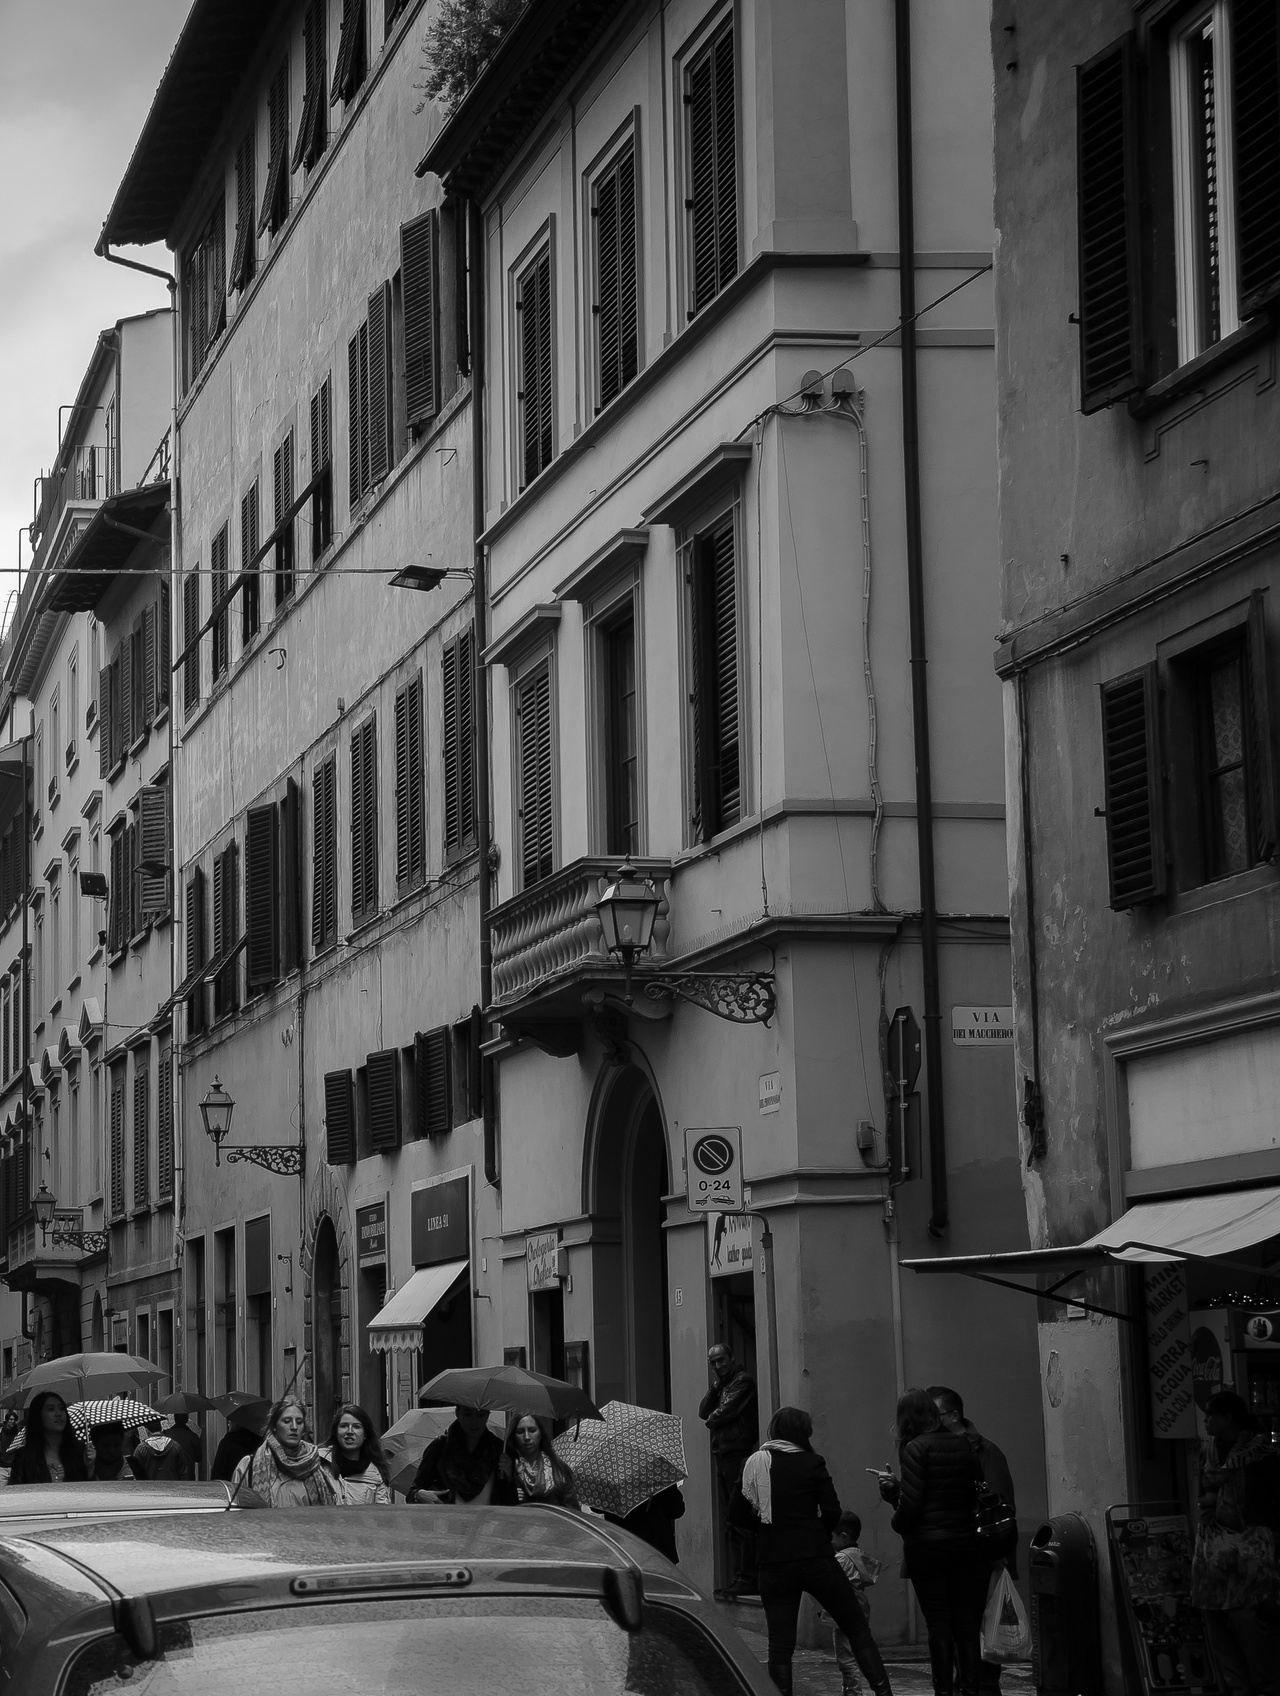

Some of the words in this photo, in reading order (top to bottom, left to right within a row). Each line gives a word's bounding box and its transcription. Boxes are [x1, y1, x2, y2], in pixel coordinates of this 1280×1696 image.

[953, 1029, 966, 1039] DEI
[968, 1029, 1014, 1039] MACCHERO
[973, 1012, 1001, 1023] VIA
[698, 1180, 731, 1192] 0-24
[1144, 1261, 1184, 1293] MINI
[1146, 1275, 1186, 1317] MARKET
[1148, 1326, 1169, 1348] COLD
[1164, 1306, 1186, 1333] DRINK
[1151, 1338, 1190, 1381] BIRRA
[1154, 1363, 1192, 1404] ACQUA
[1155, 1408, 1179, 1434] COCA
[1172, 1388, 1193, 1413] COLA
